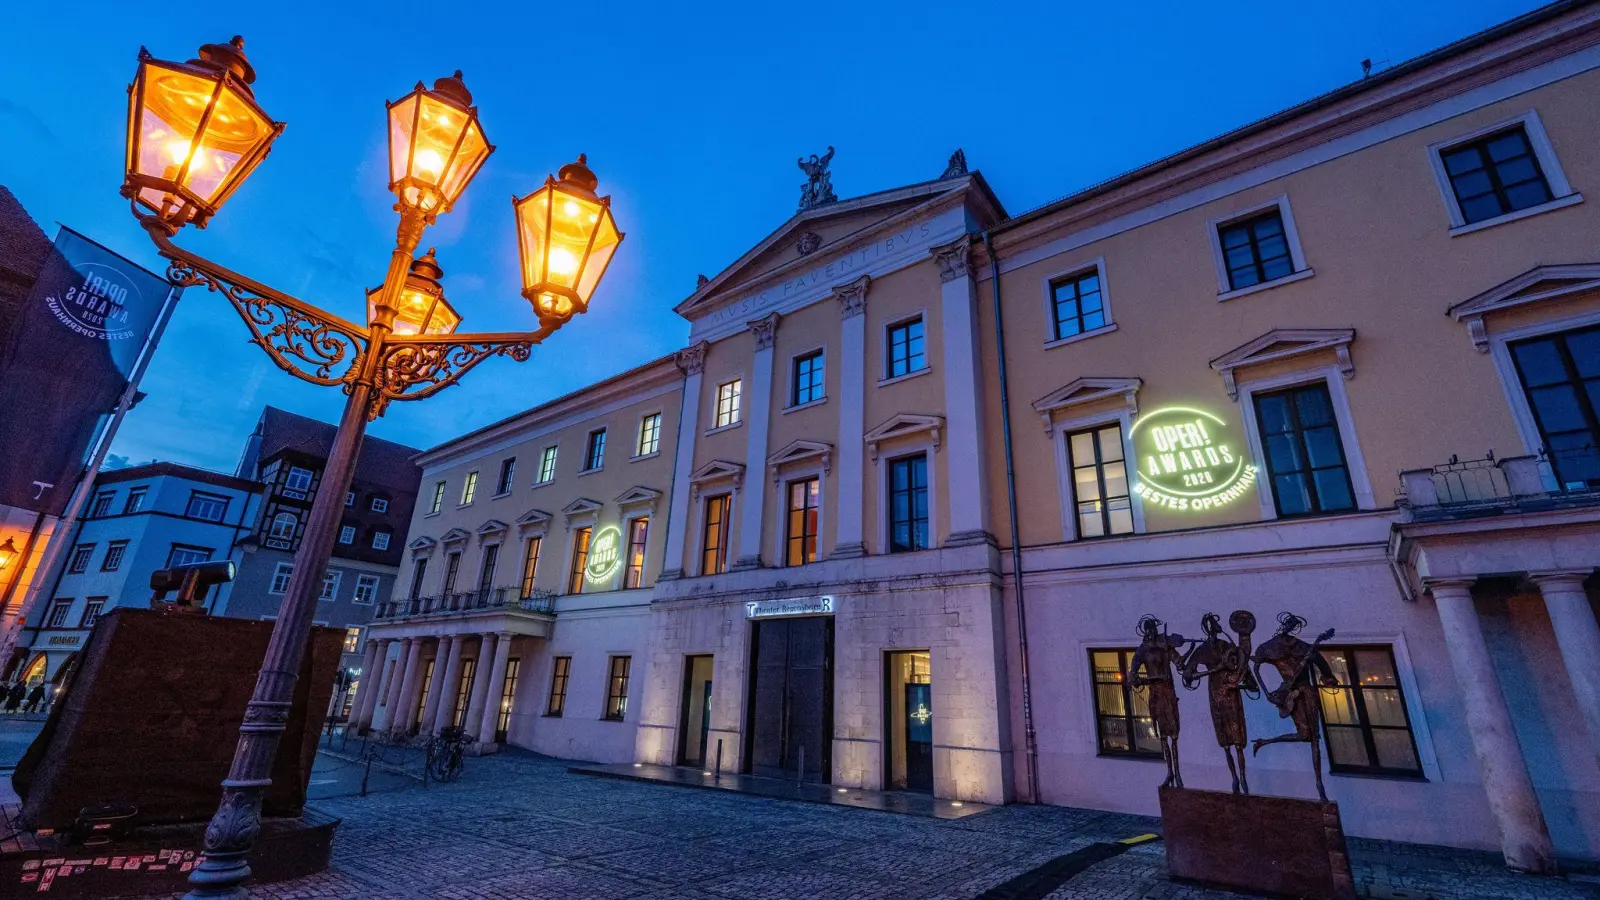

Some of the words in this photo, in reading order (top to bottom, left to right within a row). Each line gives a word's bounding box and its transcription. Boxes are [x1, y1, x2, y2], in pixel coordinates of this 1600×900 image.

[783, 222, 930, 296] FAVENTIBVS
[1151, 420, 1212, 453] OPER!
[1147, 444, 1234, 476] AWARDS
[1134, 482, 1189, 510] BESTES
[1191, 464, 1258, 510] OPERNHAUS
